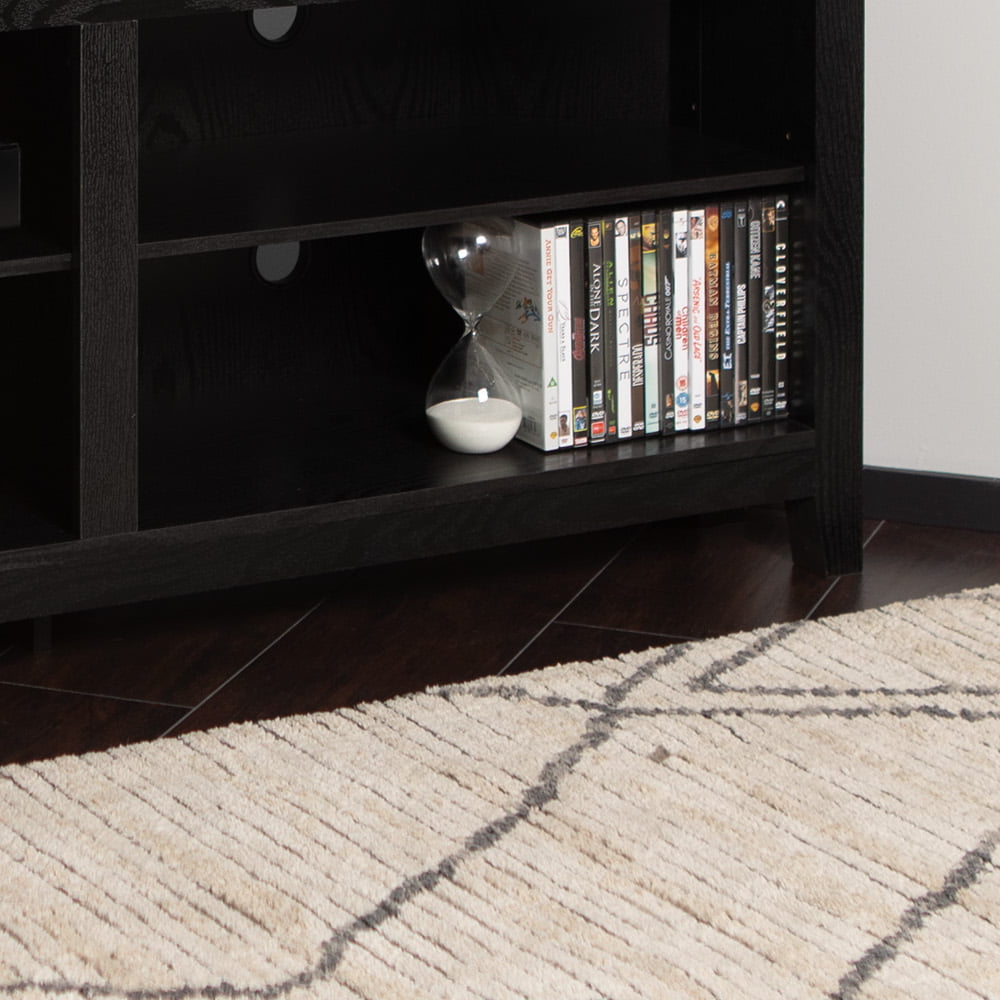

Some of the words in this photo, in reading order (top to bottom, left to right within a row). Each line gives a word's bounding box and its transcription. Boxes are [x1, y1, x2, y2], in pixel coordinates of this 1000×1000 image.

[544, 239, 552, 266] ANNIE
[593, 263, 601, 307] ALONE
[606, 261, 614, 306] ALIEN
[709, 254, 719, 306] BATMAN
[775, 243, 786, 361] CLOVERFIELD
[590, 308, 600, 354] DARK
[618, 277, 629, 381] SPECTRE
[642, 292, 659, 347] CHAOS
[709, 312, 719, 360] BEGINS
[632, 343, 643, 387] DESPERADO
